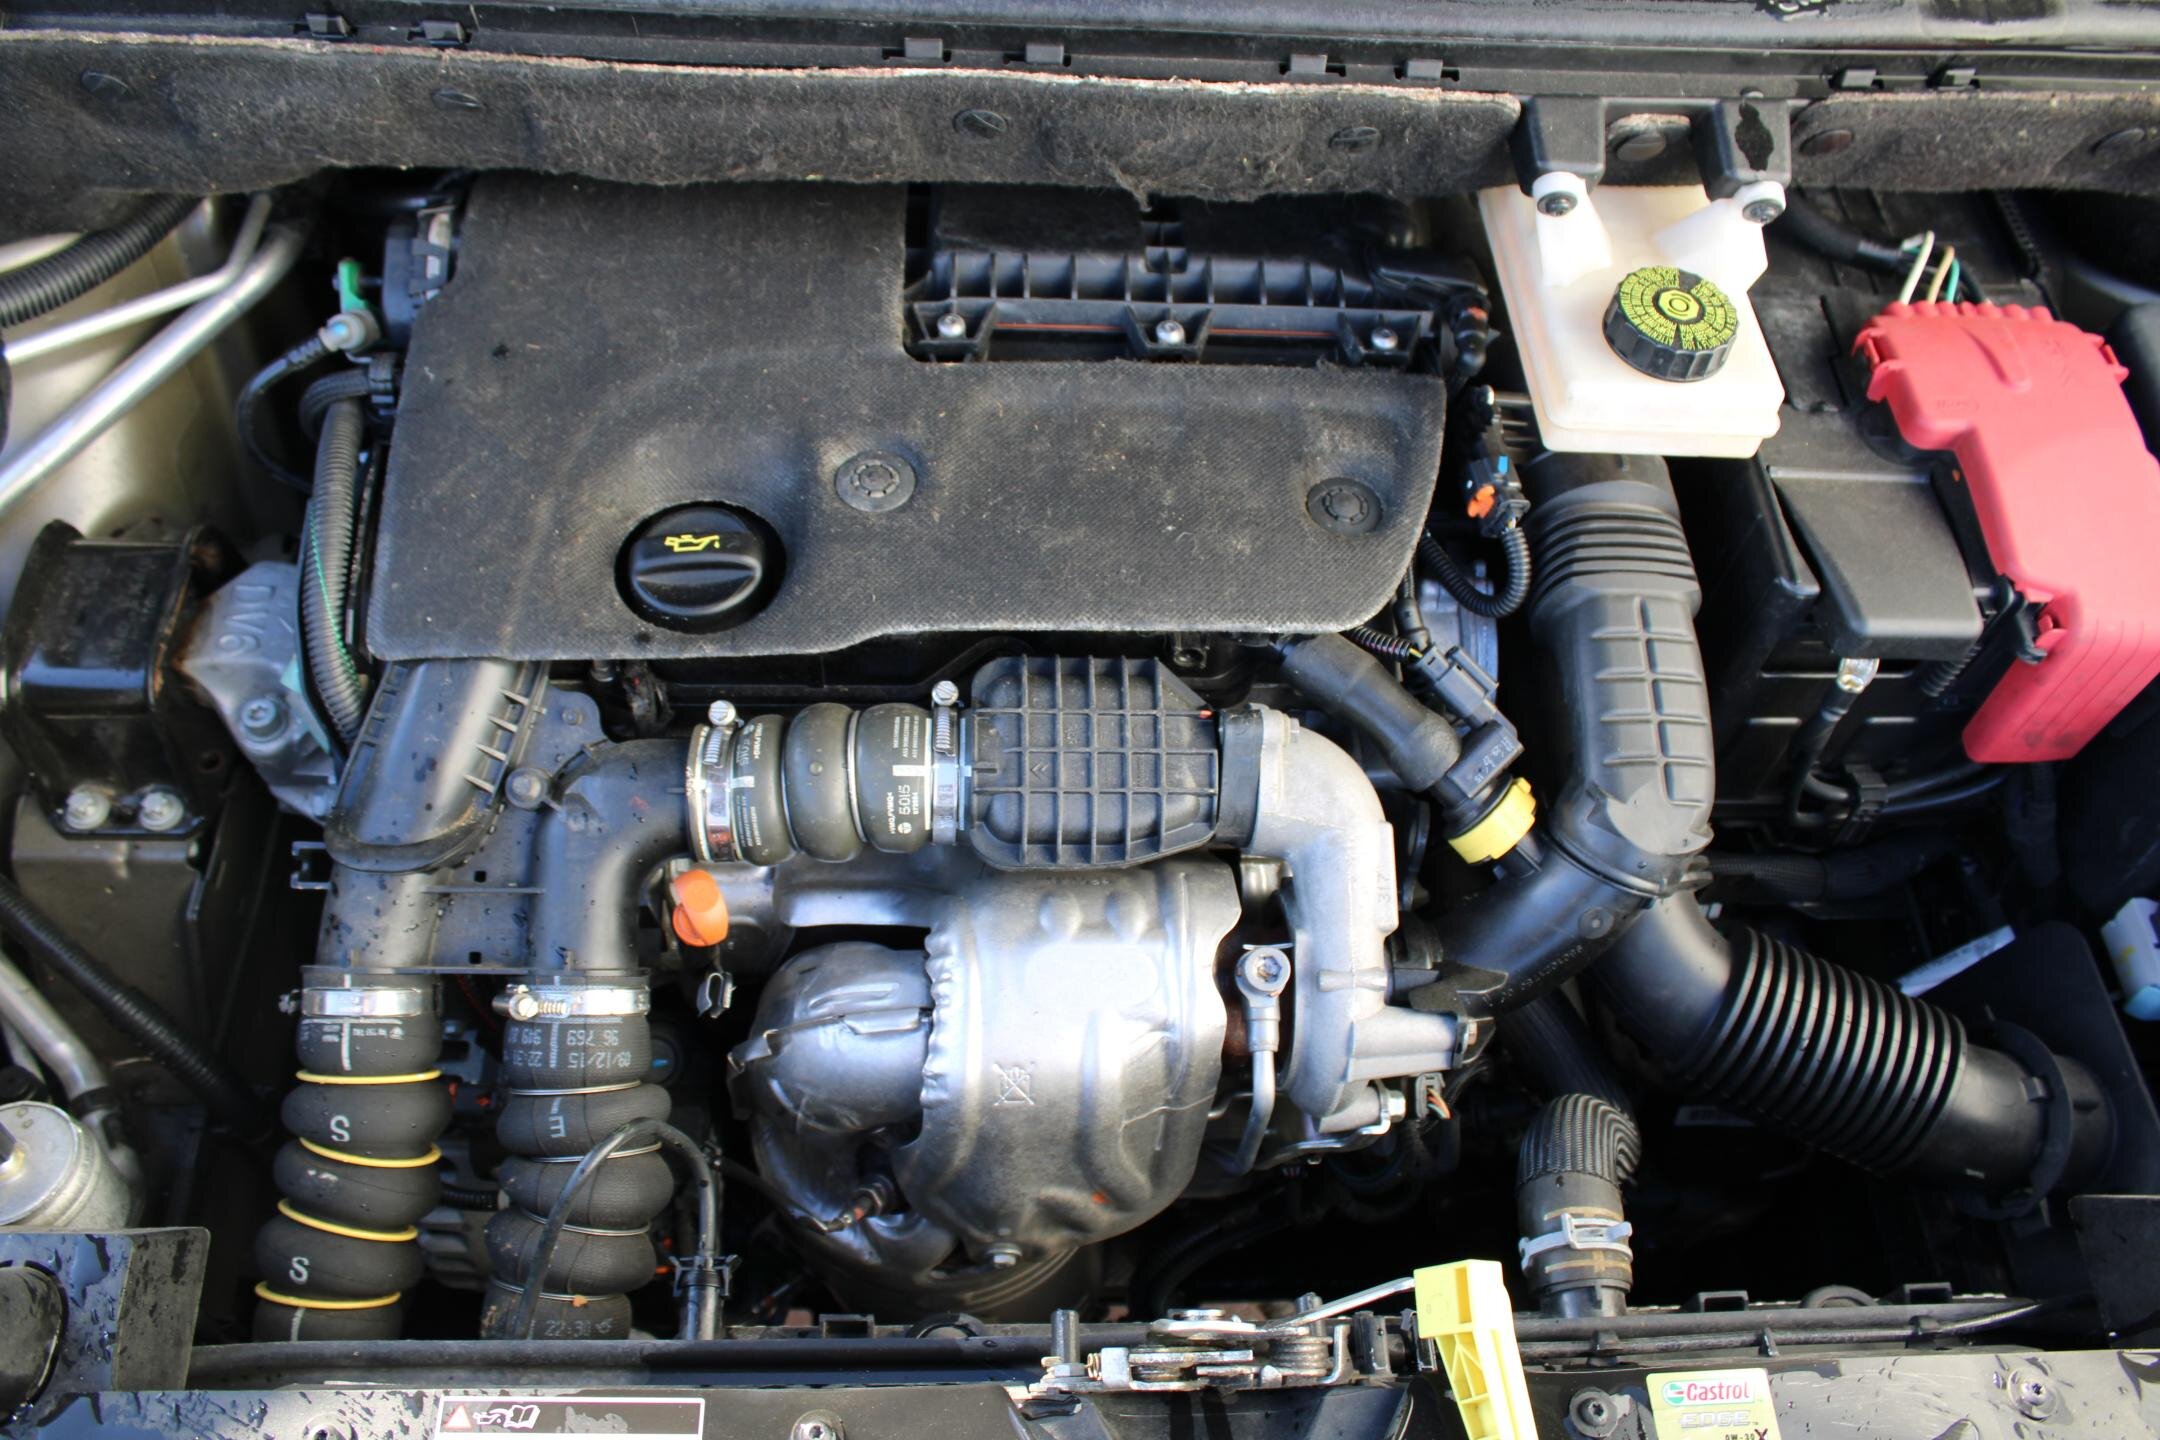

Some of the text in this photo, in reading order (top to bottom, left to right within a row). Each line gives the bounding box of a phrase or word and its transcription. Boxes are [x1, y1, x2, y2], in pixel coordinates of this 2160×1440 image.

[217, 584, 277, 657] DV6
[566, 1029, 596, 1046] 769
[330, 1114, 351, 1142] S
[289, 1257, 311, 1284] S
[1686, 1381, 1750, 1401] Castrol
[1679, 1410, 1751, 1429] EDGE
